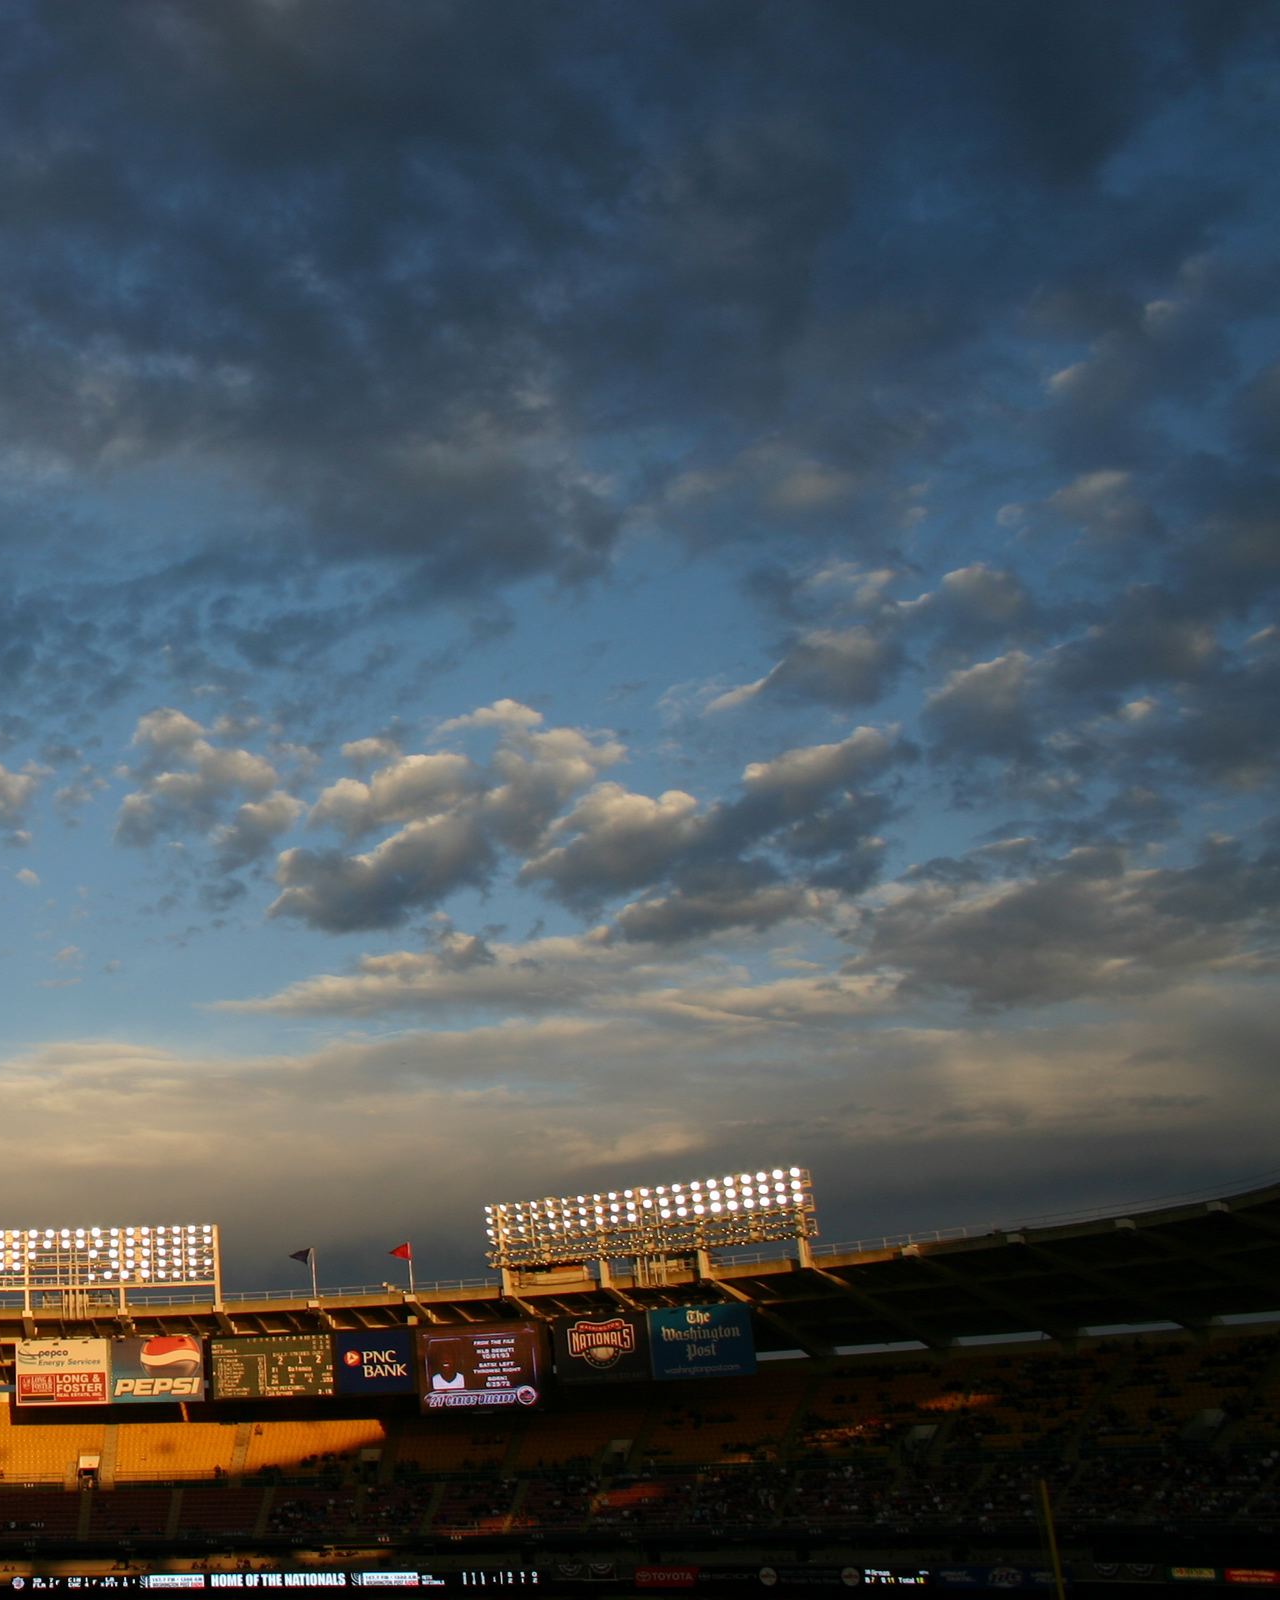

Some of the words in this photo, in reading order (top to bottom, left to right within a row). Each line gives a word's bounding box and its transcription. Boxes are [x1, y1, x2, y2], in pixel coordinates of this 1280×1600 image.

[686, 1309, 711, 1325] The
[578, 1322, 620, 1331] WASHINGTON
[572, 1329, 631, 1353] NATIONALS
[661, 1325, 741, 1344] Washington
[38, 1350, 68, 1359] pepco
[362, 1350, 396, 1364] PNC
[686, 1342, 717, 1361] Post
[38, 1359, 64, 1368] Energy
[67, 1358, 100, 1366] Services
[278, 1356, 283, 1365] 2
[315, 1355, 322, 1364] 2
[363, 1363, 408, 1378] BANK
[56, 1374, 88, 1384] LONG
[92, 1373, 100, 1383] &
[57, 1383, 103, 1393] FOSTER
[114, 1377, 201, 1397] PEPSI
[210, 1574, 244, 1588] HOME
[245, 1573, 259, 1587] OF
[260, 1573, 282, 1587] THE
[283, 1572, 346, 1586] NATIONALS
[652, 1571, 694, 1581] TOYOTA
